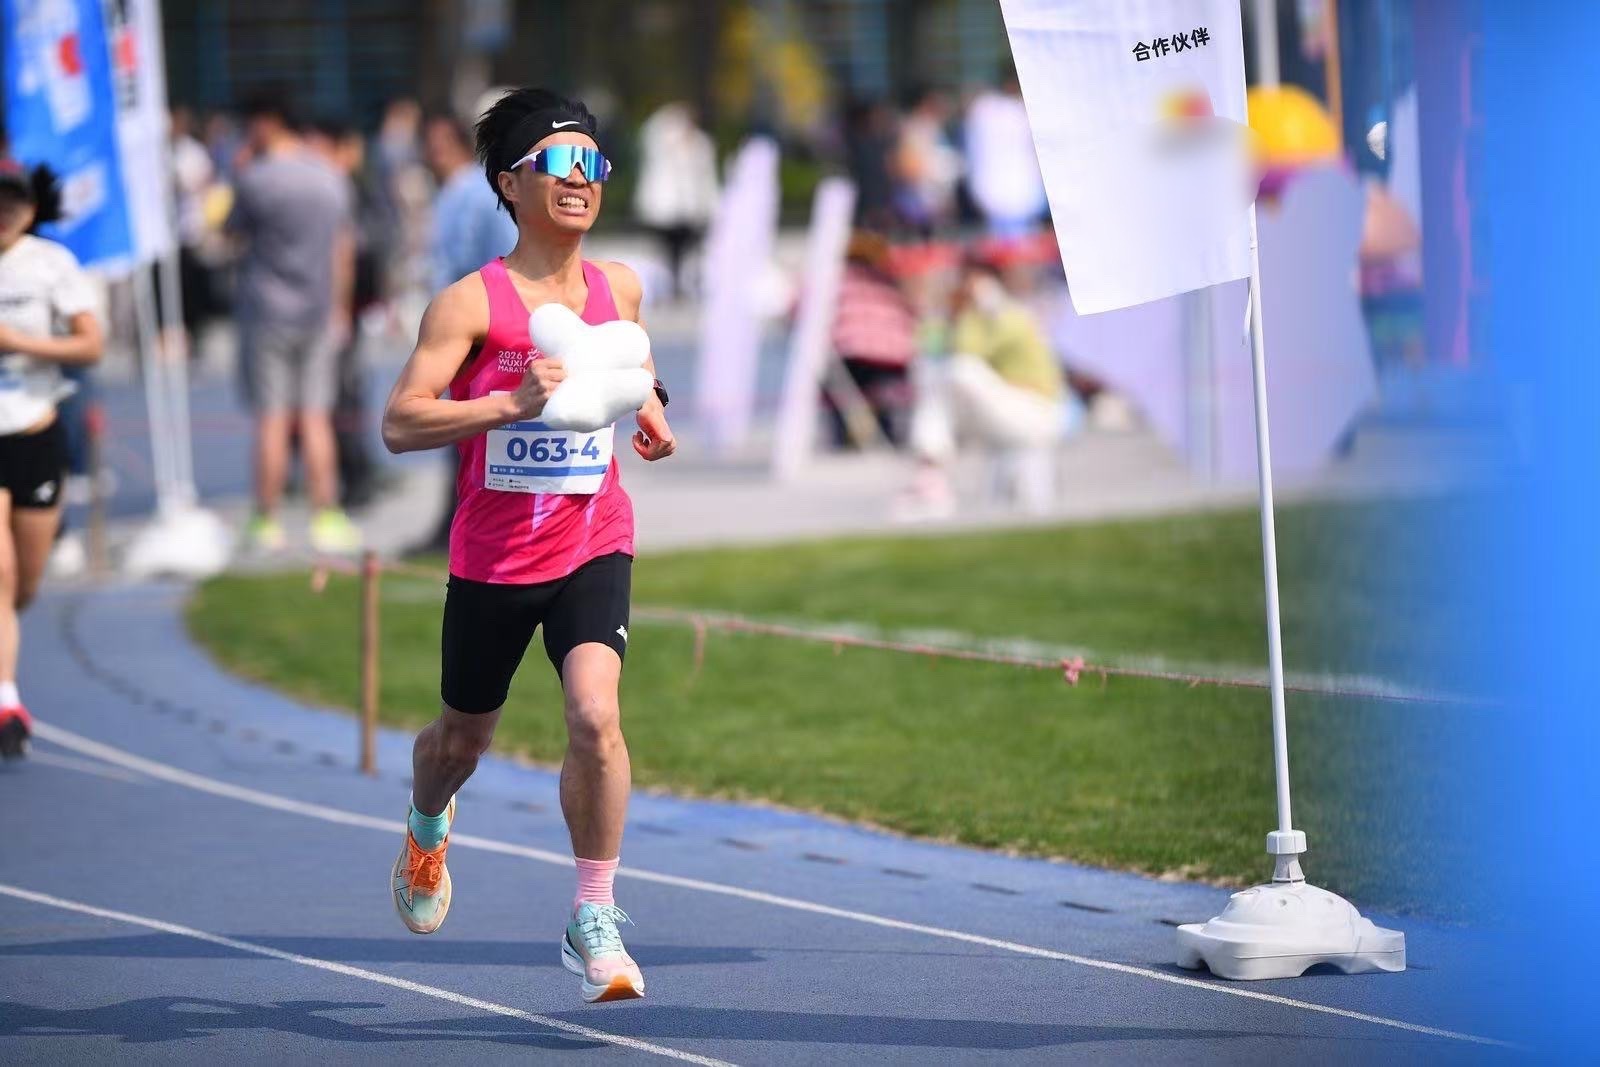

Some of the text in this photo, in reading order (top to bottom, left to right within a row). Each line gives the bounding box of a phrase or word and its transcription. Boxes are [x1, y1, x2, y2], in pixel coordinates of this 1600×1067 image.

[1132, 27, 1211, 62] 合作伙伴
[498, 350, 523, 360] 2026
[498, 358, 523, 367] WUXI
[506, 436, 600, 463] 063-4
